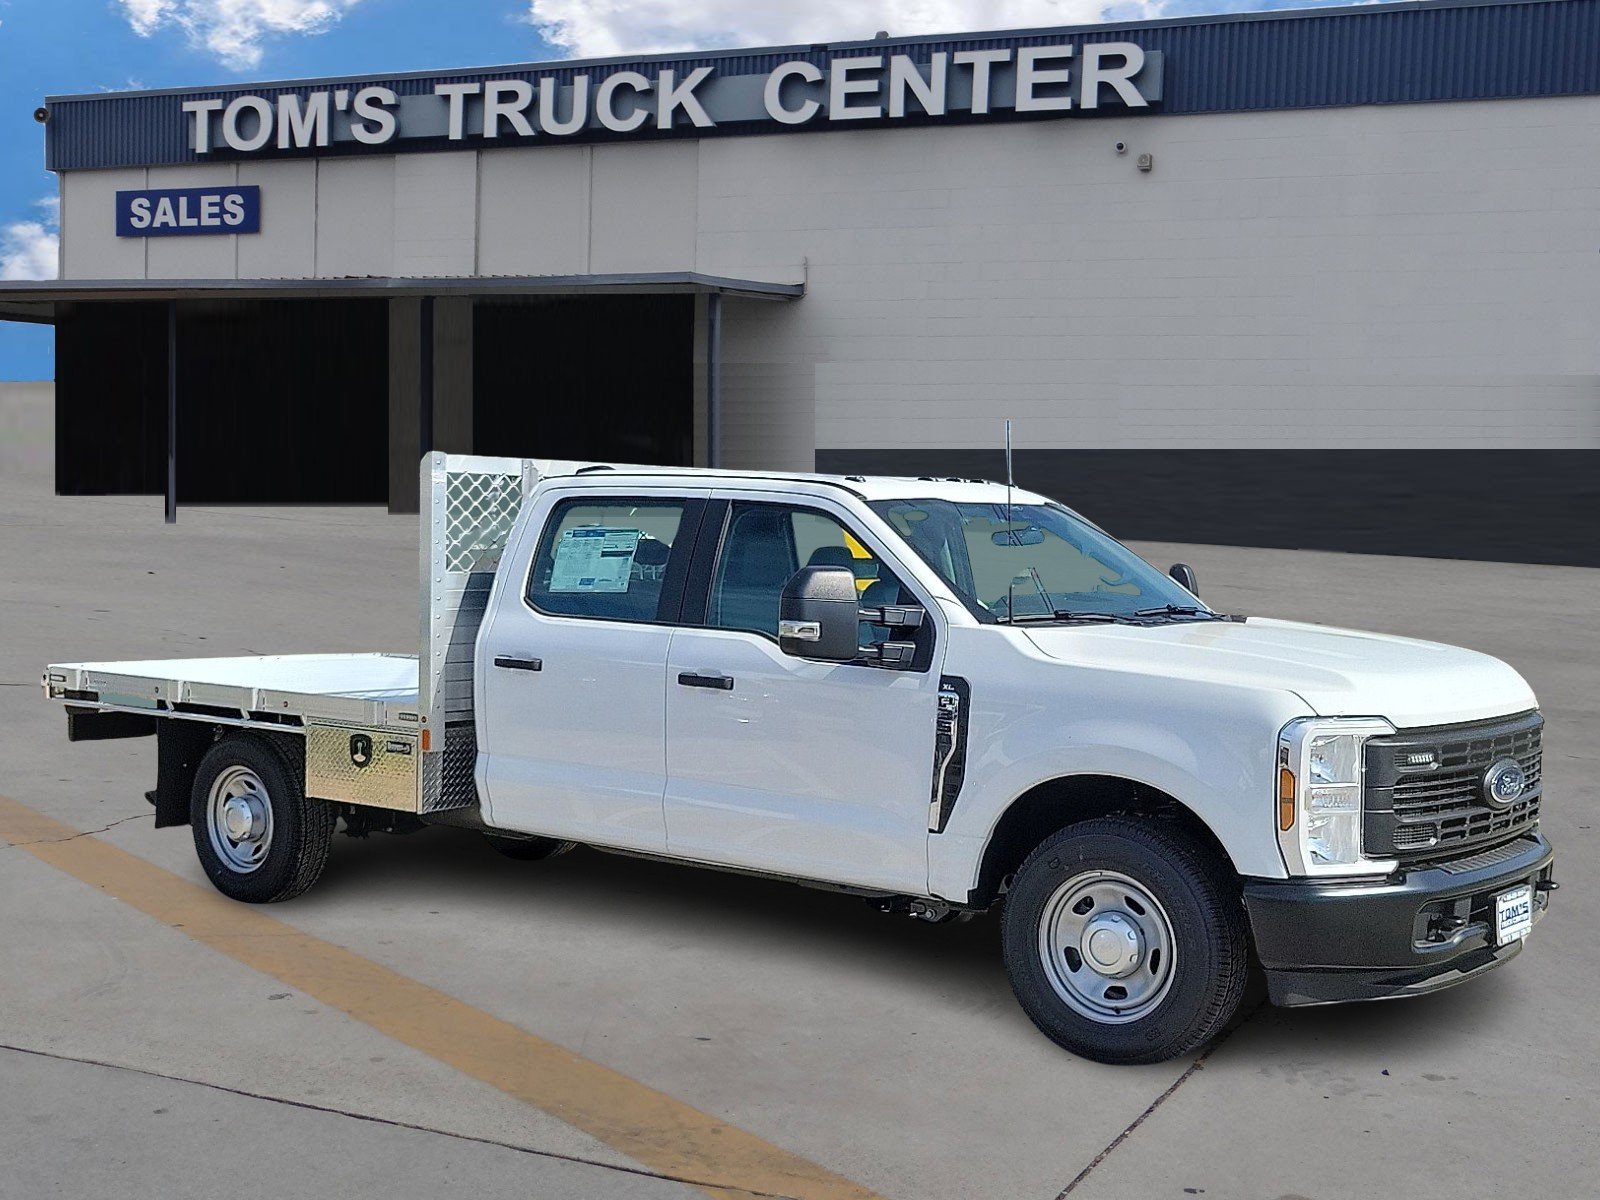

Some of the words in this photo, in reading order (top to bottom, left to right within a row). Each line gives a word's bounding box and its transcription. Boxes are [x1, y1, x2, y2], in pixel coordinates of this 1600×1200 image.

[182, 86, 397, 154] TOM'S
[434, 66, 716, 140] TRUCK
[763, 42, 1150, 125] CENTER
[130, 194, 245, 229] SALES
[942, 683, 955, 691] XL
[1499, 901, 1530, 923] TOM'S
